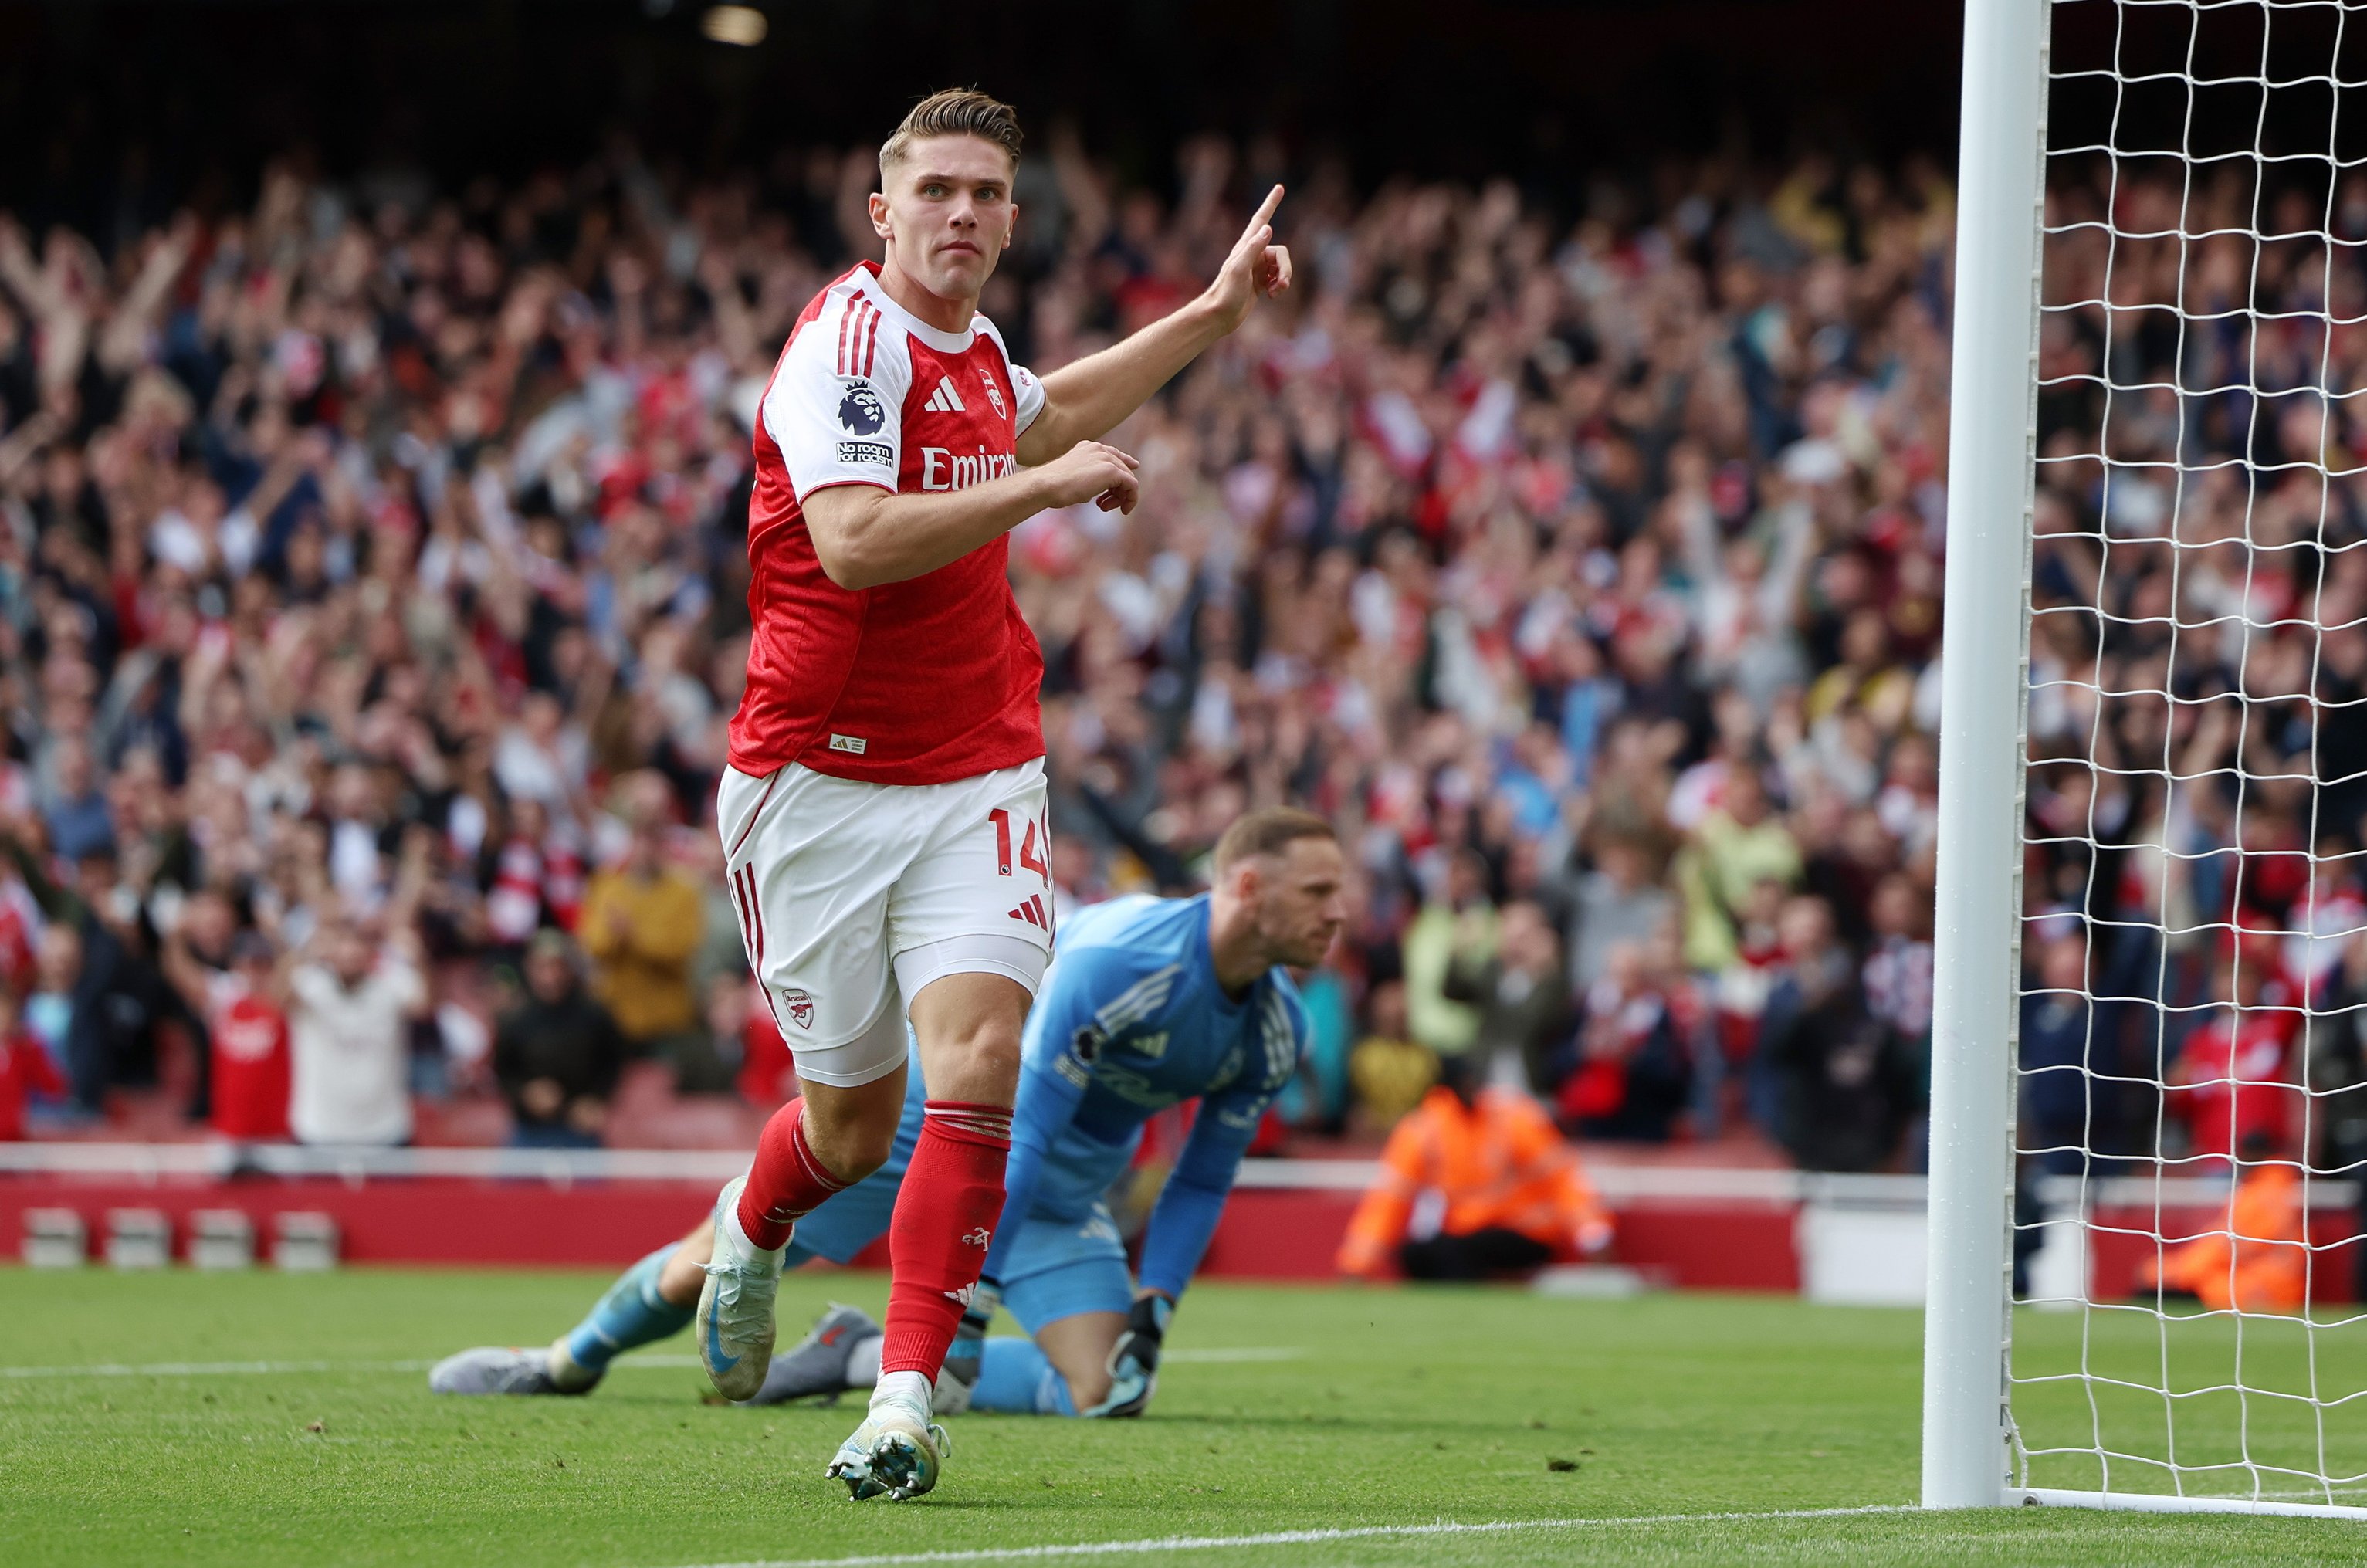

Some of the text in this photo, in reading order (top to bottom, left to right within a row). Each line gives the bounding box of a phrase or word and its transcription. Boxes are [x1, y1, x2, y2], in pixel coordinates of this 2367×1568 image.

[836, 442, 889, 457] No room
[837, 452, 893, 468] for racism
[921, 445, 1017, 490] Emirat
[989, 808, 1049, 891] 14
